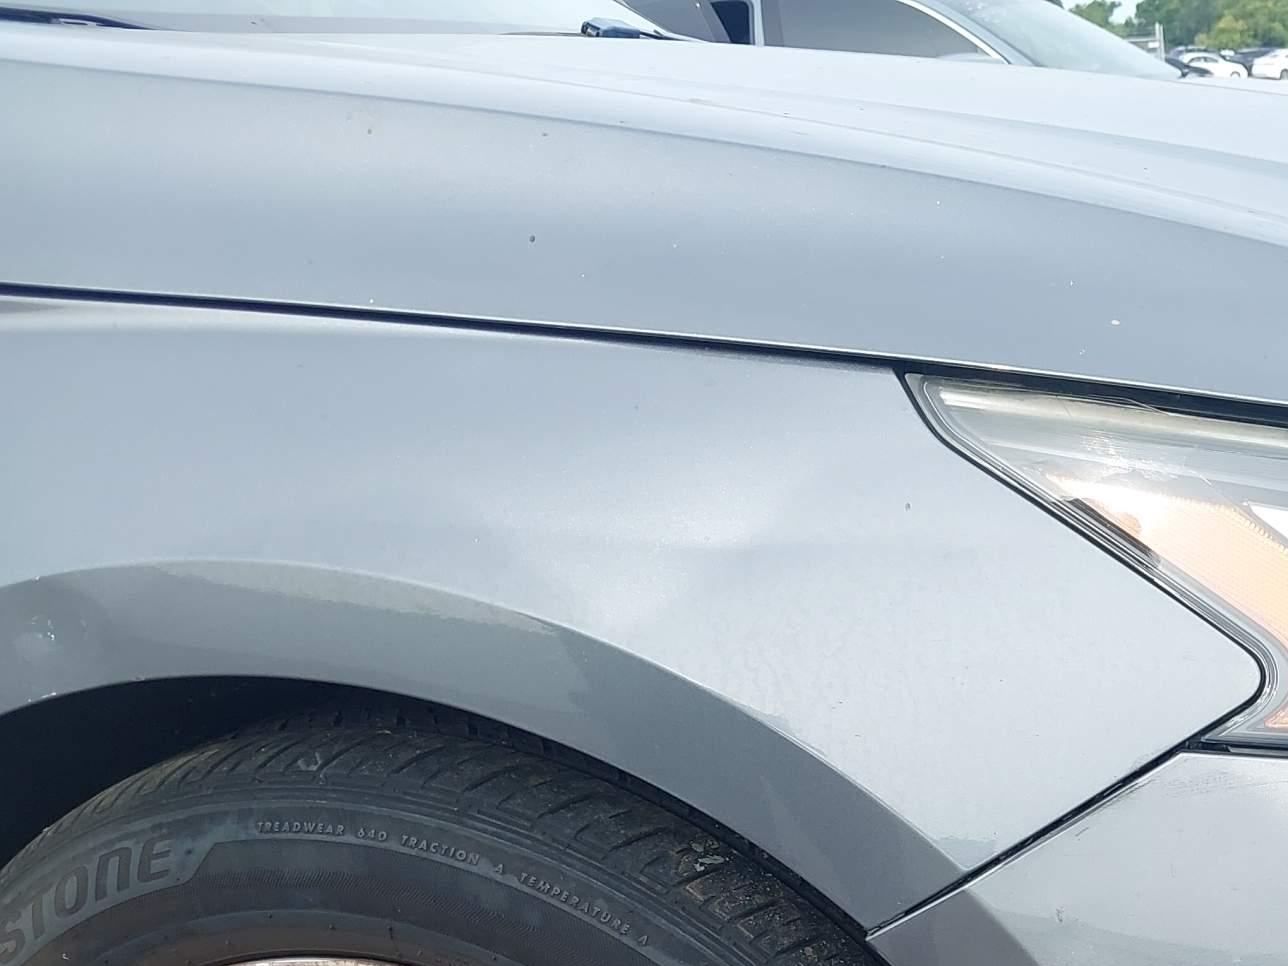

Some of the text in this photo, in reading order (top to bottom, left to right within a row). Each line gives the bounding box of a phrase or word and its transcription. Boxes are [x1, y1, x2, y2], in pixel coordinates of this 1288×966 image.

[256, 820, 649, 946] TREADWEAR 640 TRACTION A TEMPERATURE A
